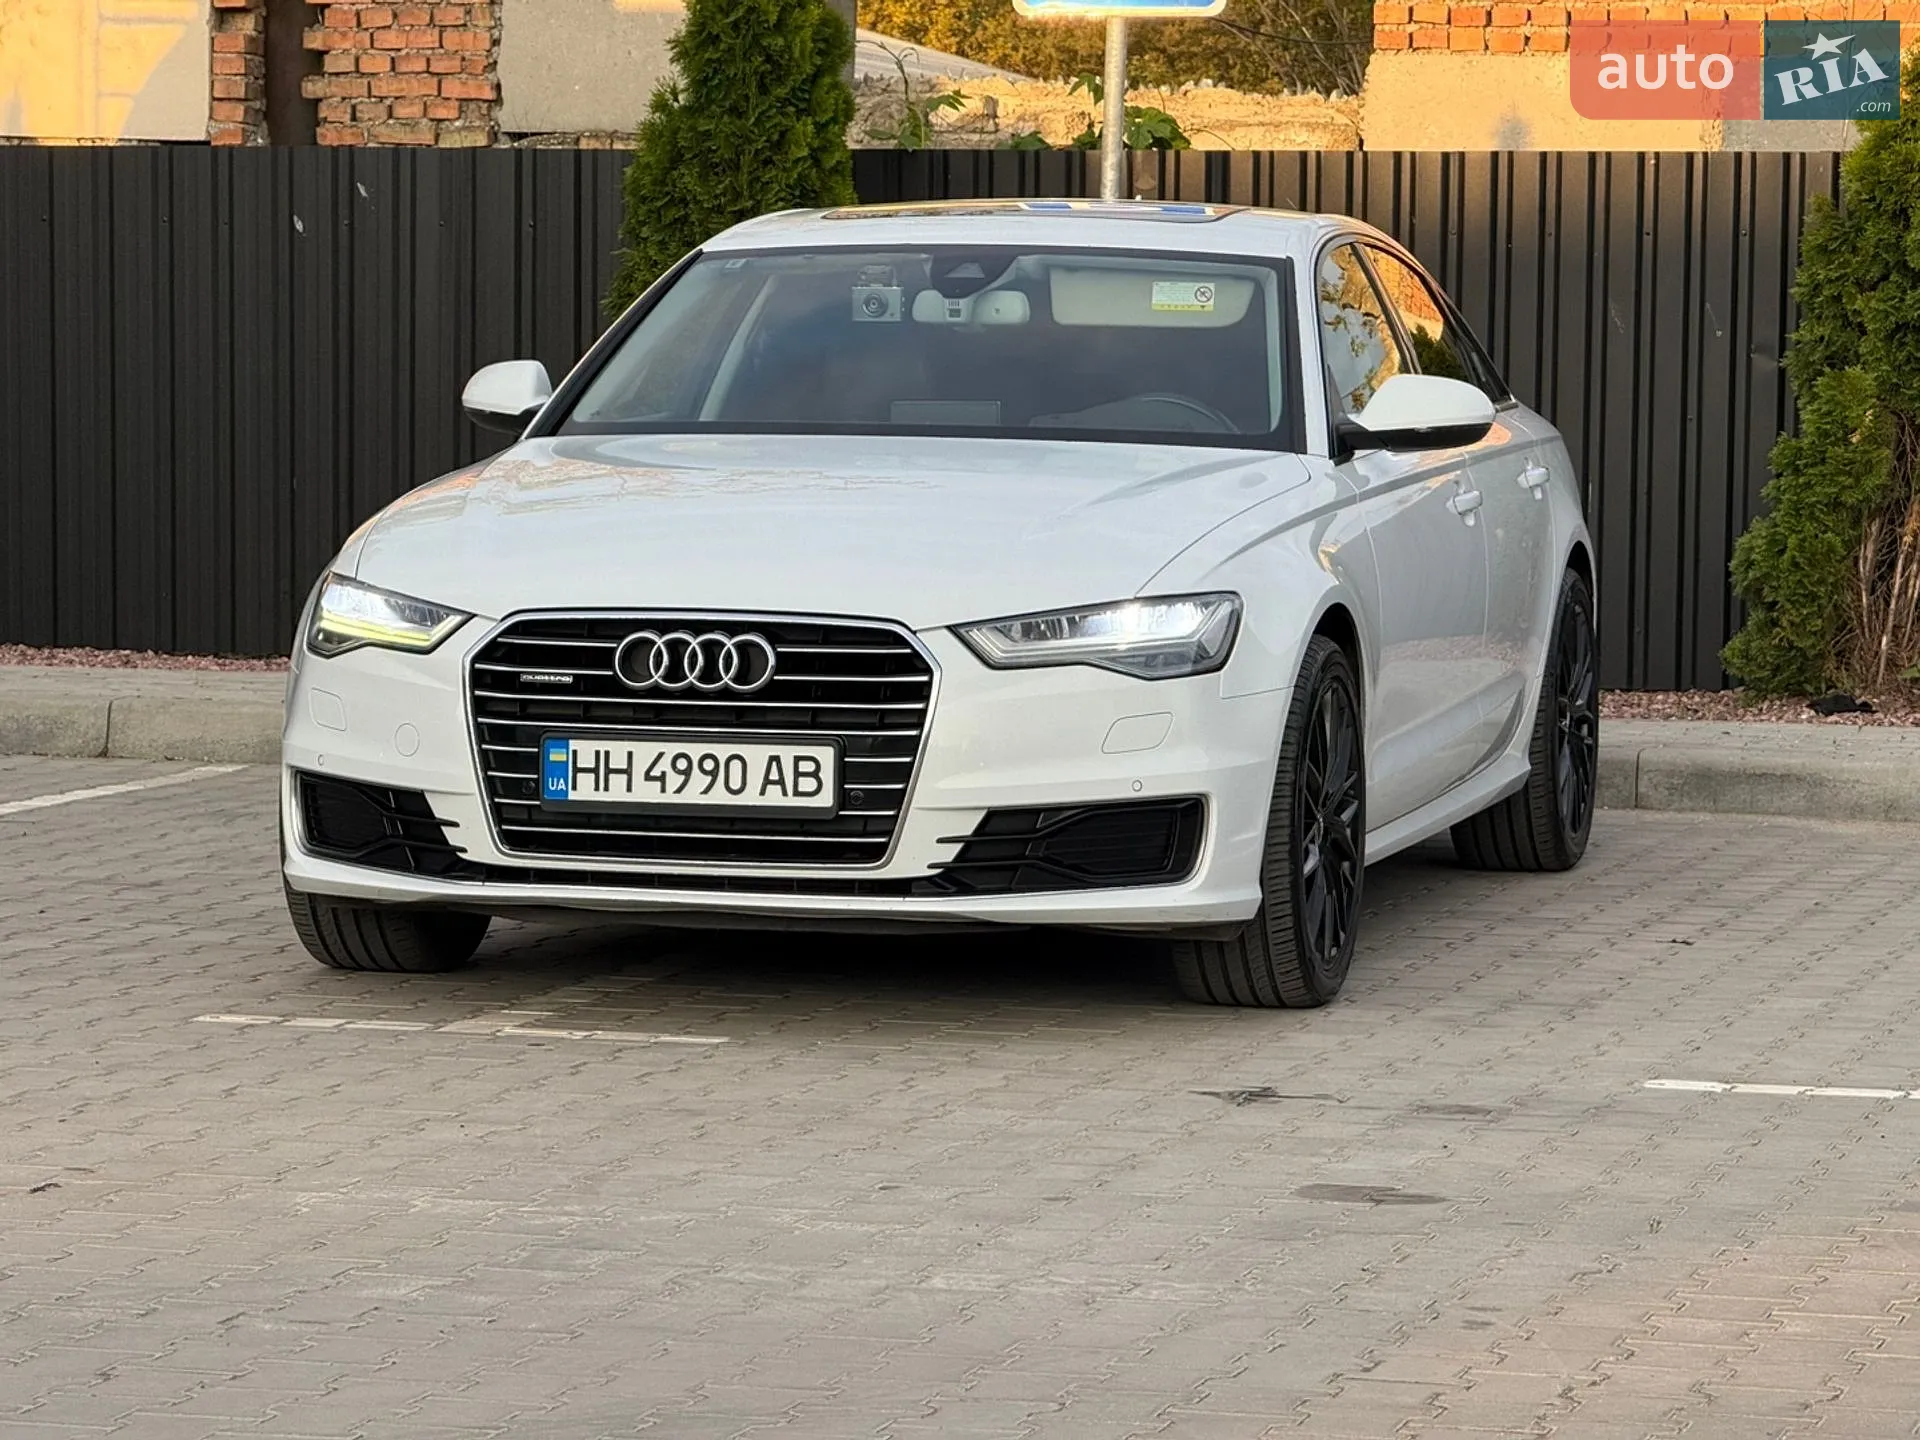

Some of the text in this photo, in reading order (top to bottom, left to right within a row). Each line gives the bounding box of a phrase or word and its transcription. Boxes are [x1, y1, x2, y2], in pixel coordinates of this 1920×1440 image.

[549, 778, 566, 791] UA
[571, 748, 823, 798] HH 4990 AB
